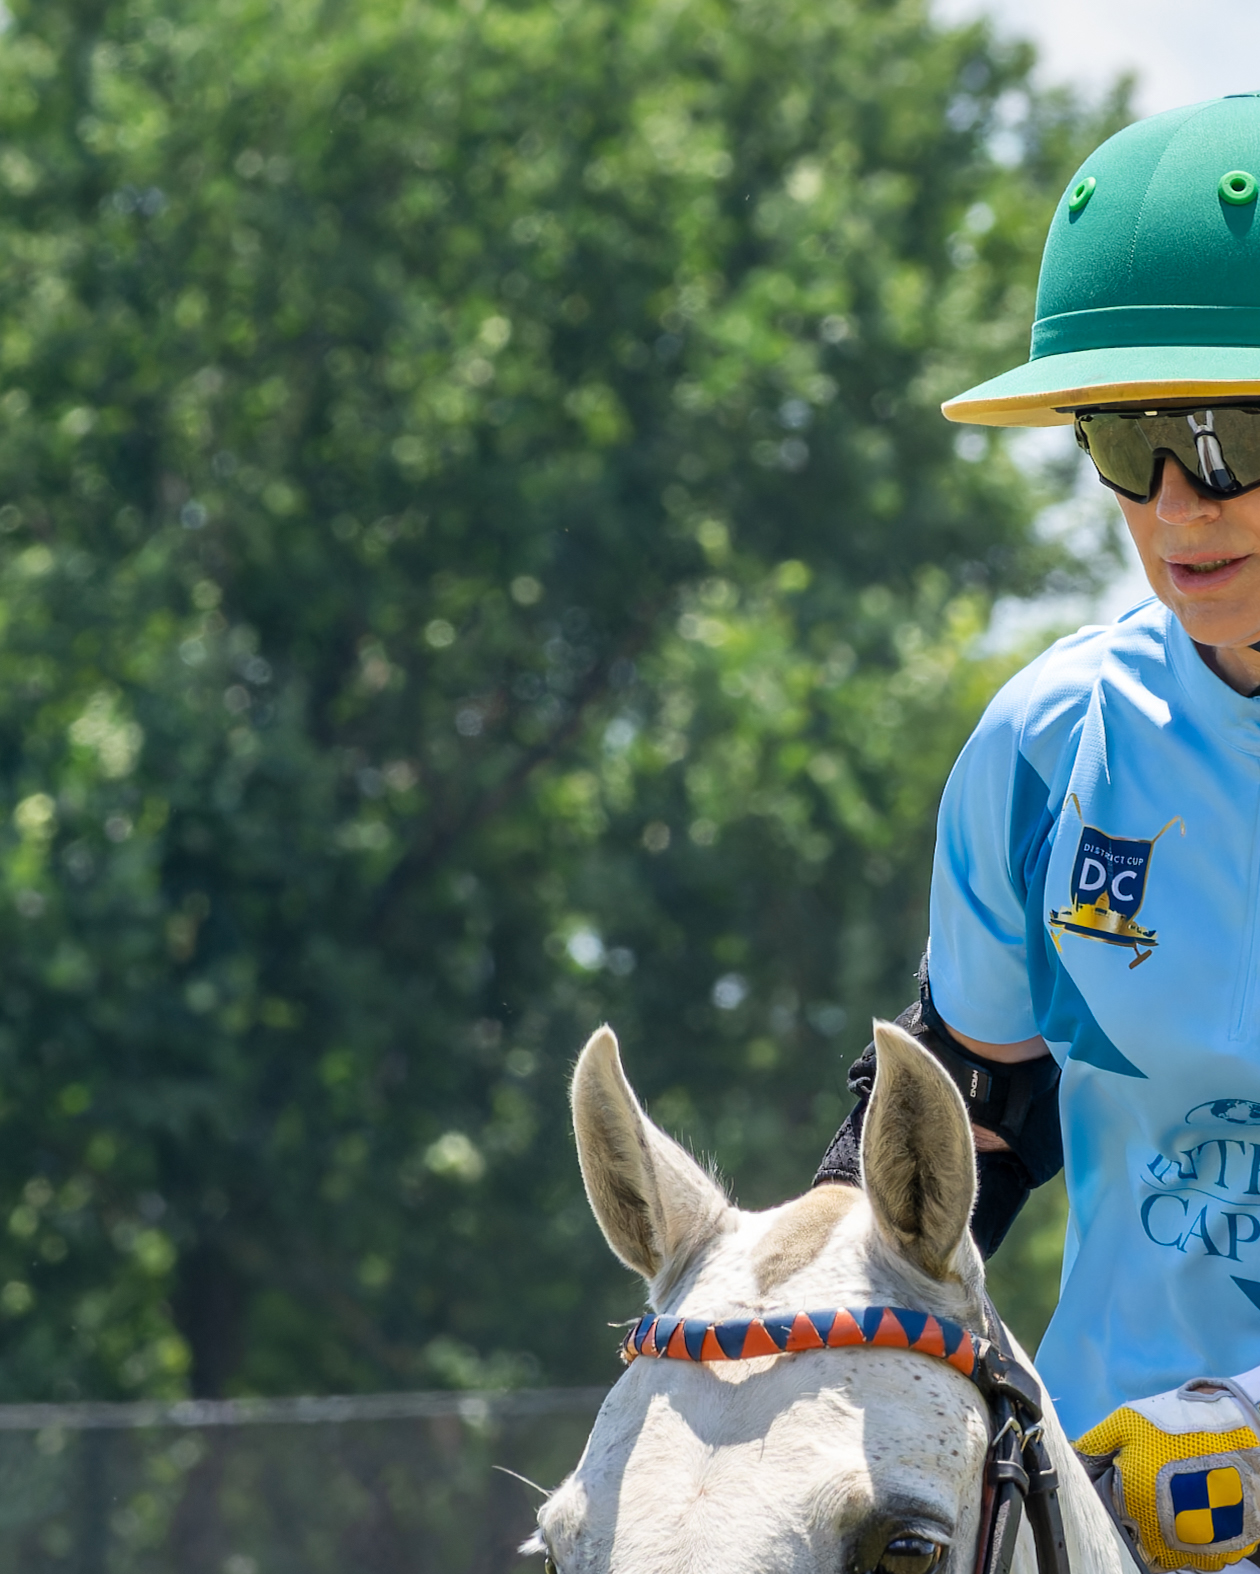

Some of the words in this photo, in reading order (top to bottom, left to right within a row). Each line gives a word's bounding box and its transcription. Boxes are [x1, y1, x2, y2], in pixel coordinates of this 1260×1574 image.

[1083, 843, 1125, 864] DISTRICT
[1127, 856, 1144, 865] CUP
[1078, 857, 1138, 901] DC
